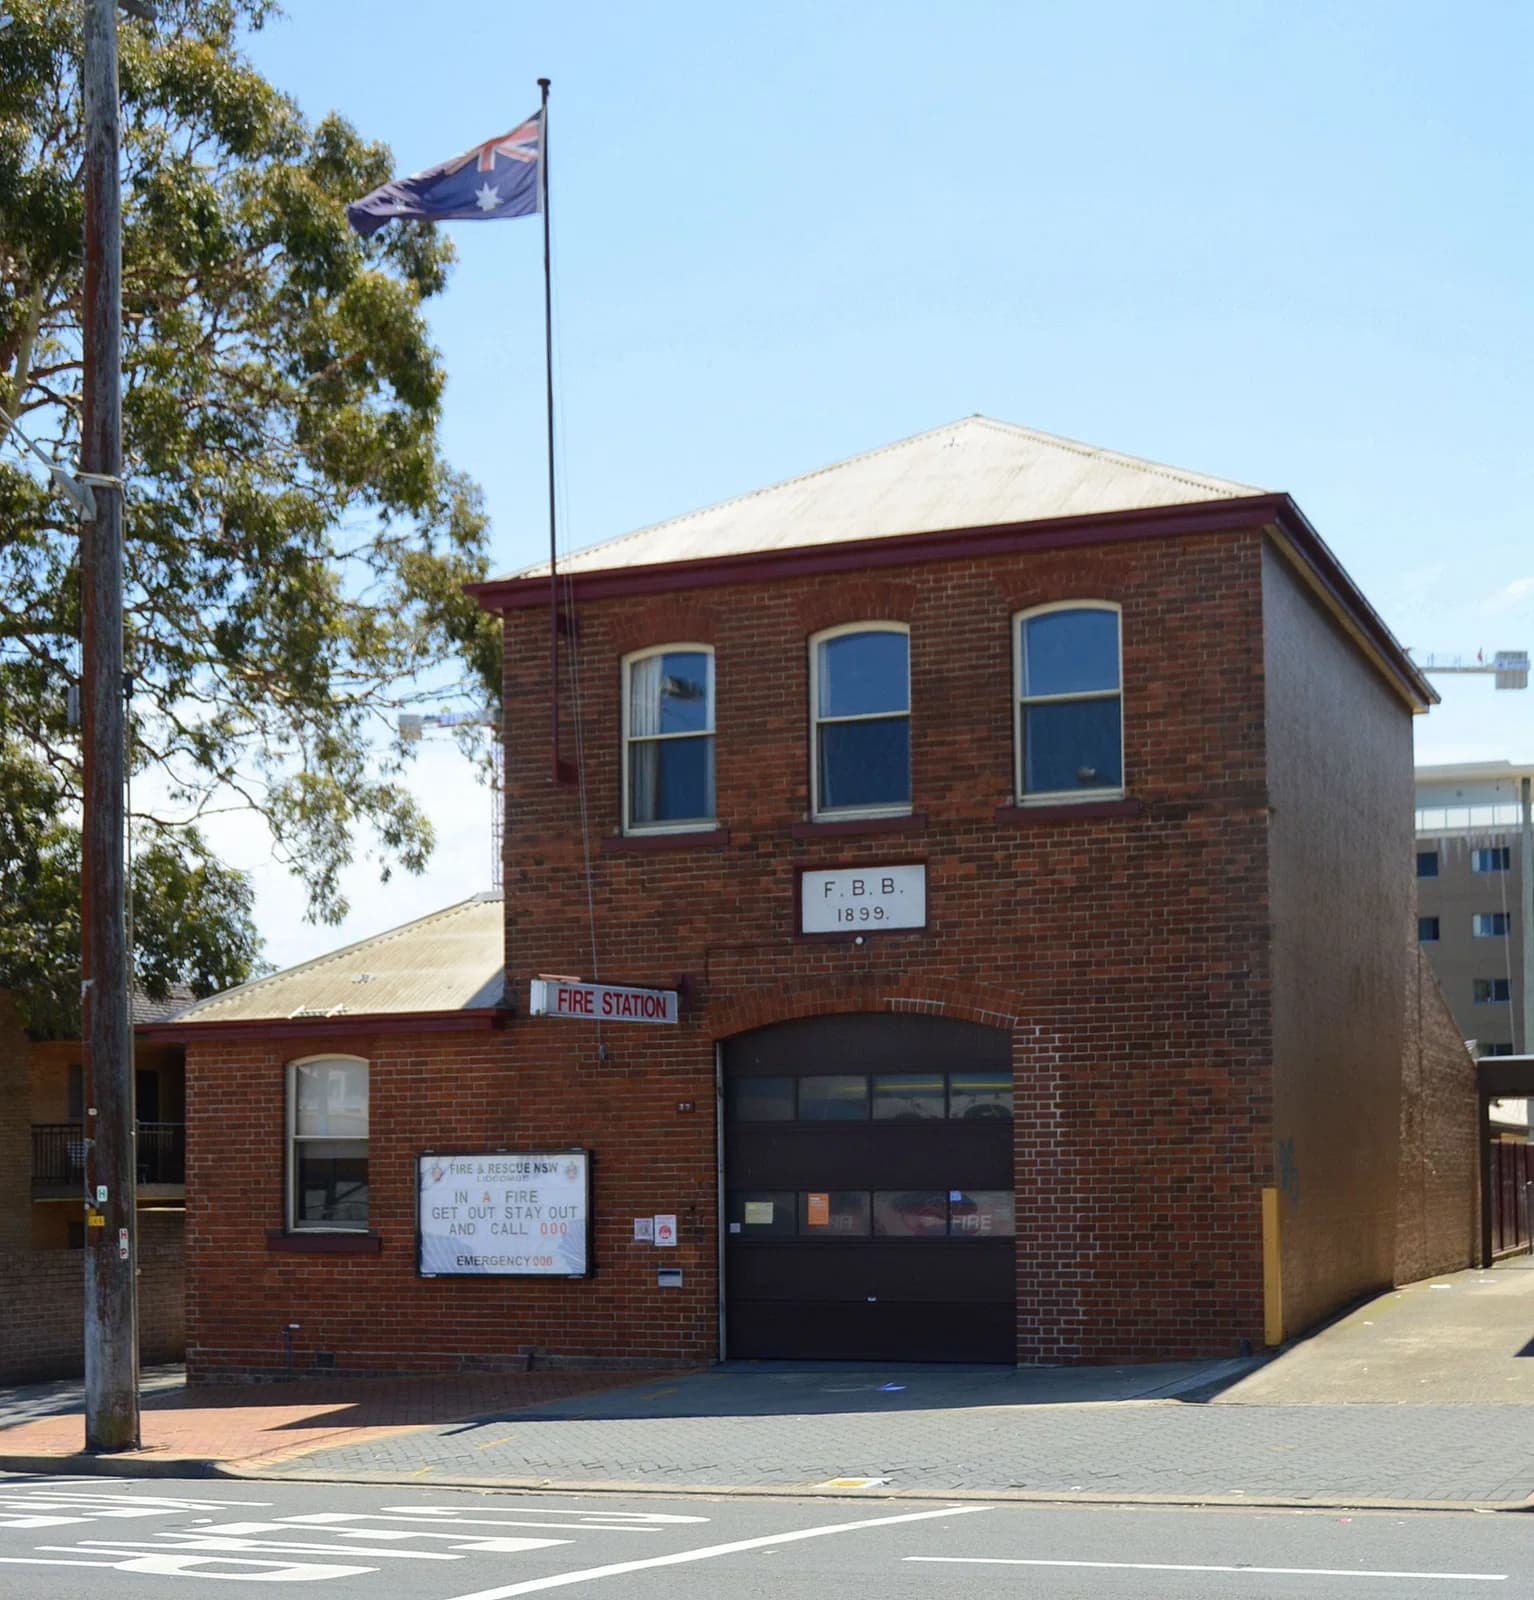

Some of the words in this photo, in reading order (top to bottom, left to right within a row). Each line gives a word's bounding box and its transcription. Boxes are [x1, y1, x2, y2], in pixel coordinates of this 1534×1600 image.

[838, 906, 889, 922] 1899.
[557, 988, 594, 1014] FIRE
[602, 991, 667, 1018] STATION
[450, 1163, 473, 1175] FIRE
[488, 1162, 530, 1174] RESCUE
[534, 1161, 558, 1173] NSW
[455, 1191, 468, 1203] IN
[482, 1191, 491, 1203] A
[505, 1190, 538, 1203] FIRE
[432, 1207, 458, 1220] GET
[468, 1206, 496, 1219] OUT
[505, 1206, 542, 1219] STAY
[548, 1206, 578, 1219] OUT
[449, 1223, 476, 1235] AND
[490, 1222, 528, 1235] CALL
[540, 1222, 568, 1235] 000
[951, 1214, 992, 1230] FIRE
[456, 1255, 529, 1266] EMERGENCY
[0, 1506, 711, 1582] CLEAR
